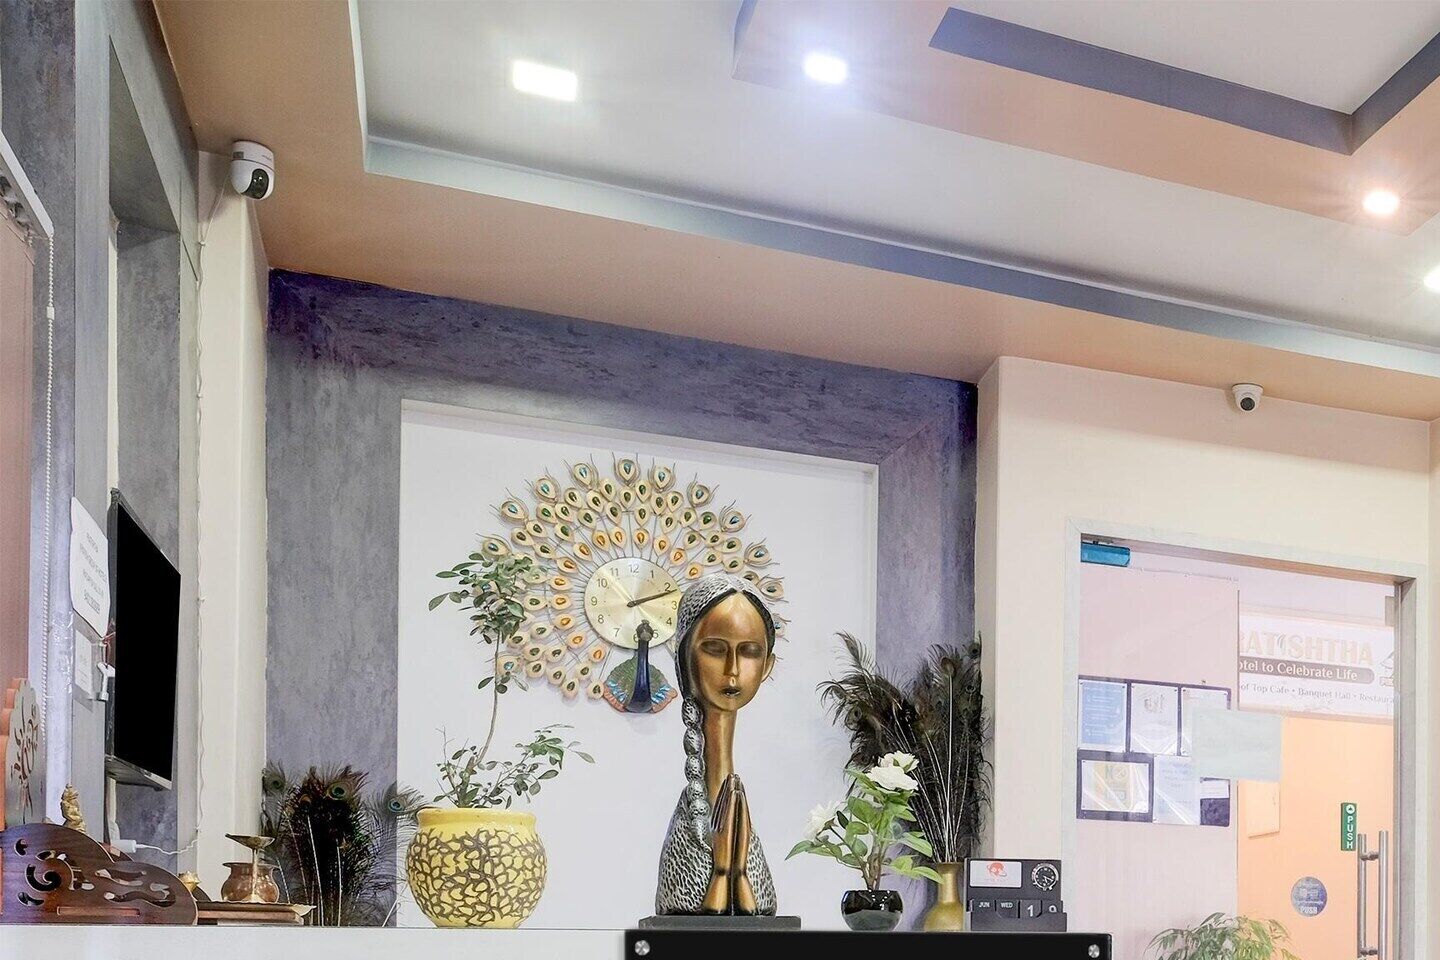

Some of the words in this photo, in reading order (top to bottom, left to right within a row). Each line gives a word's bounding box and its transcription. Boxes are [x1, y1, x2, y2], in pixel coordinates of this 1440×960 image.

[610, 567, 619, 577] 11
[628, 564, 640, 574] 12
[597, 578, 608, 588] 10
[664, 582, 671, 592] 2
[591, 596, 598, 606] 9
[671, 600, 678, 610] 3
[597, 614, 604, 624] 8
[666, 617, 672, 626] 4
[613, 627, 620, 637] 7
[1262, 660, 1274, 673] to
[1277, 662, 1333, 679] Celebrate
[1336, 668, 1358, 681] Life
[1298, 687, 1332, 699] Banquet
[1346, 816, 1354, 849] PUSH
